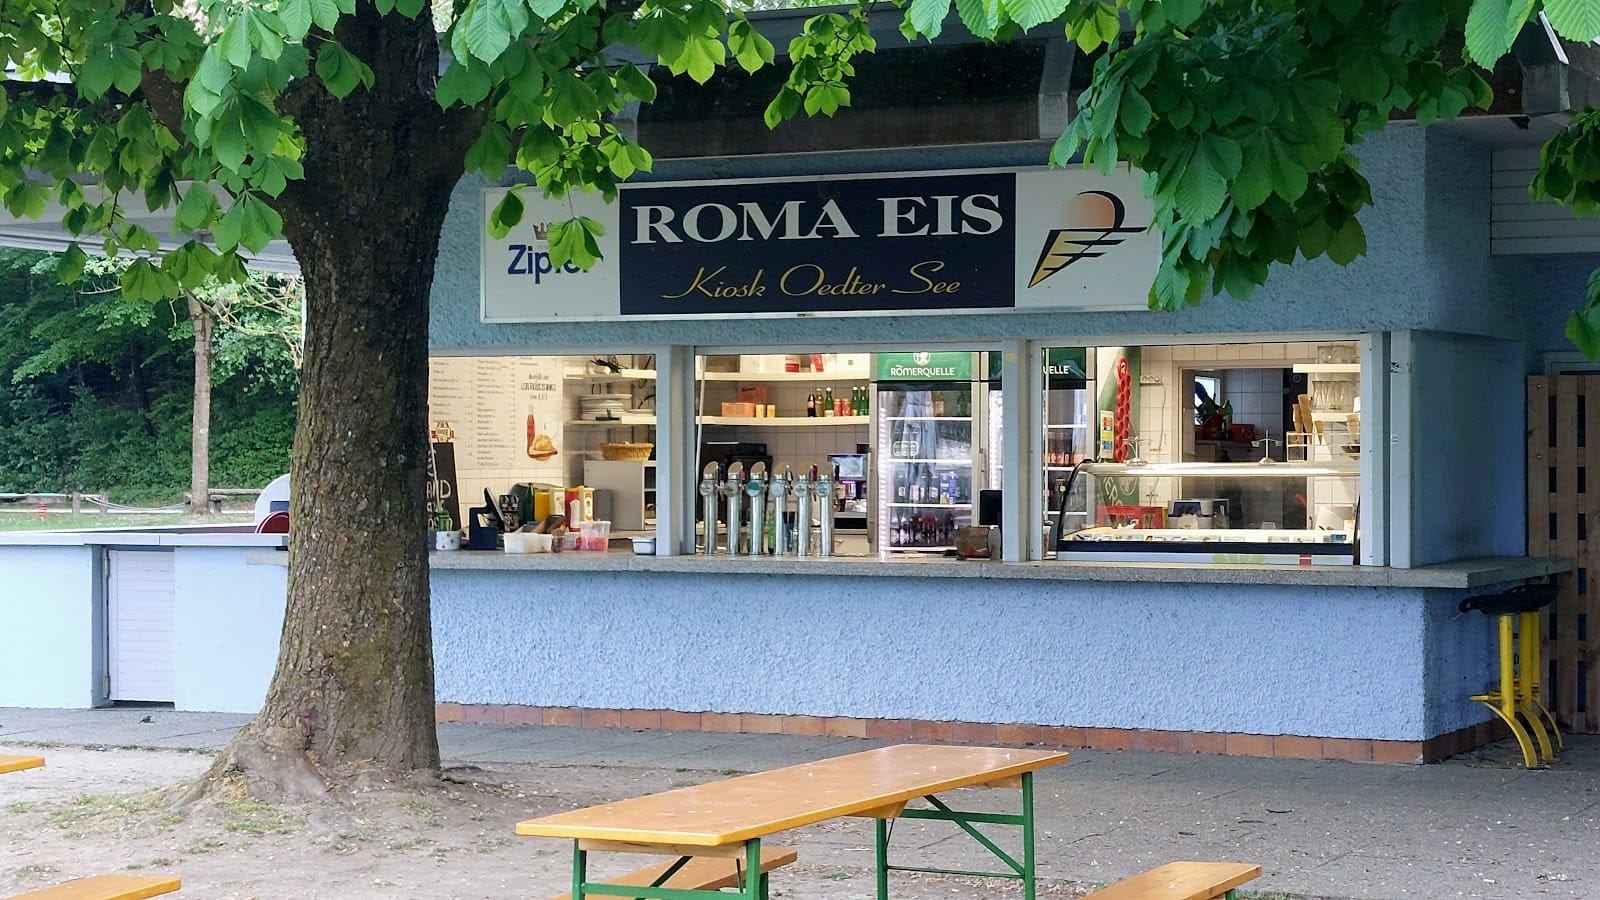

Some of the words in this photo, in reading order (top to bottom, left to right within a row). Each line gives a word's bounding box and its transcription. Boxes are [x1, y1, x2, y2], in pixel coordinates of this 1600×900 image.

[630, 198, 861, 244] ROMA
[876, 193, 1004, 237] EIS
[661, 265, 767, 299] Kiosk
[779, 263, 886, 296] Oedter
[891, 260, 961, 294] See
